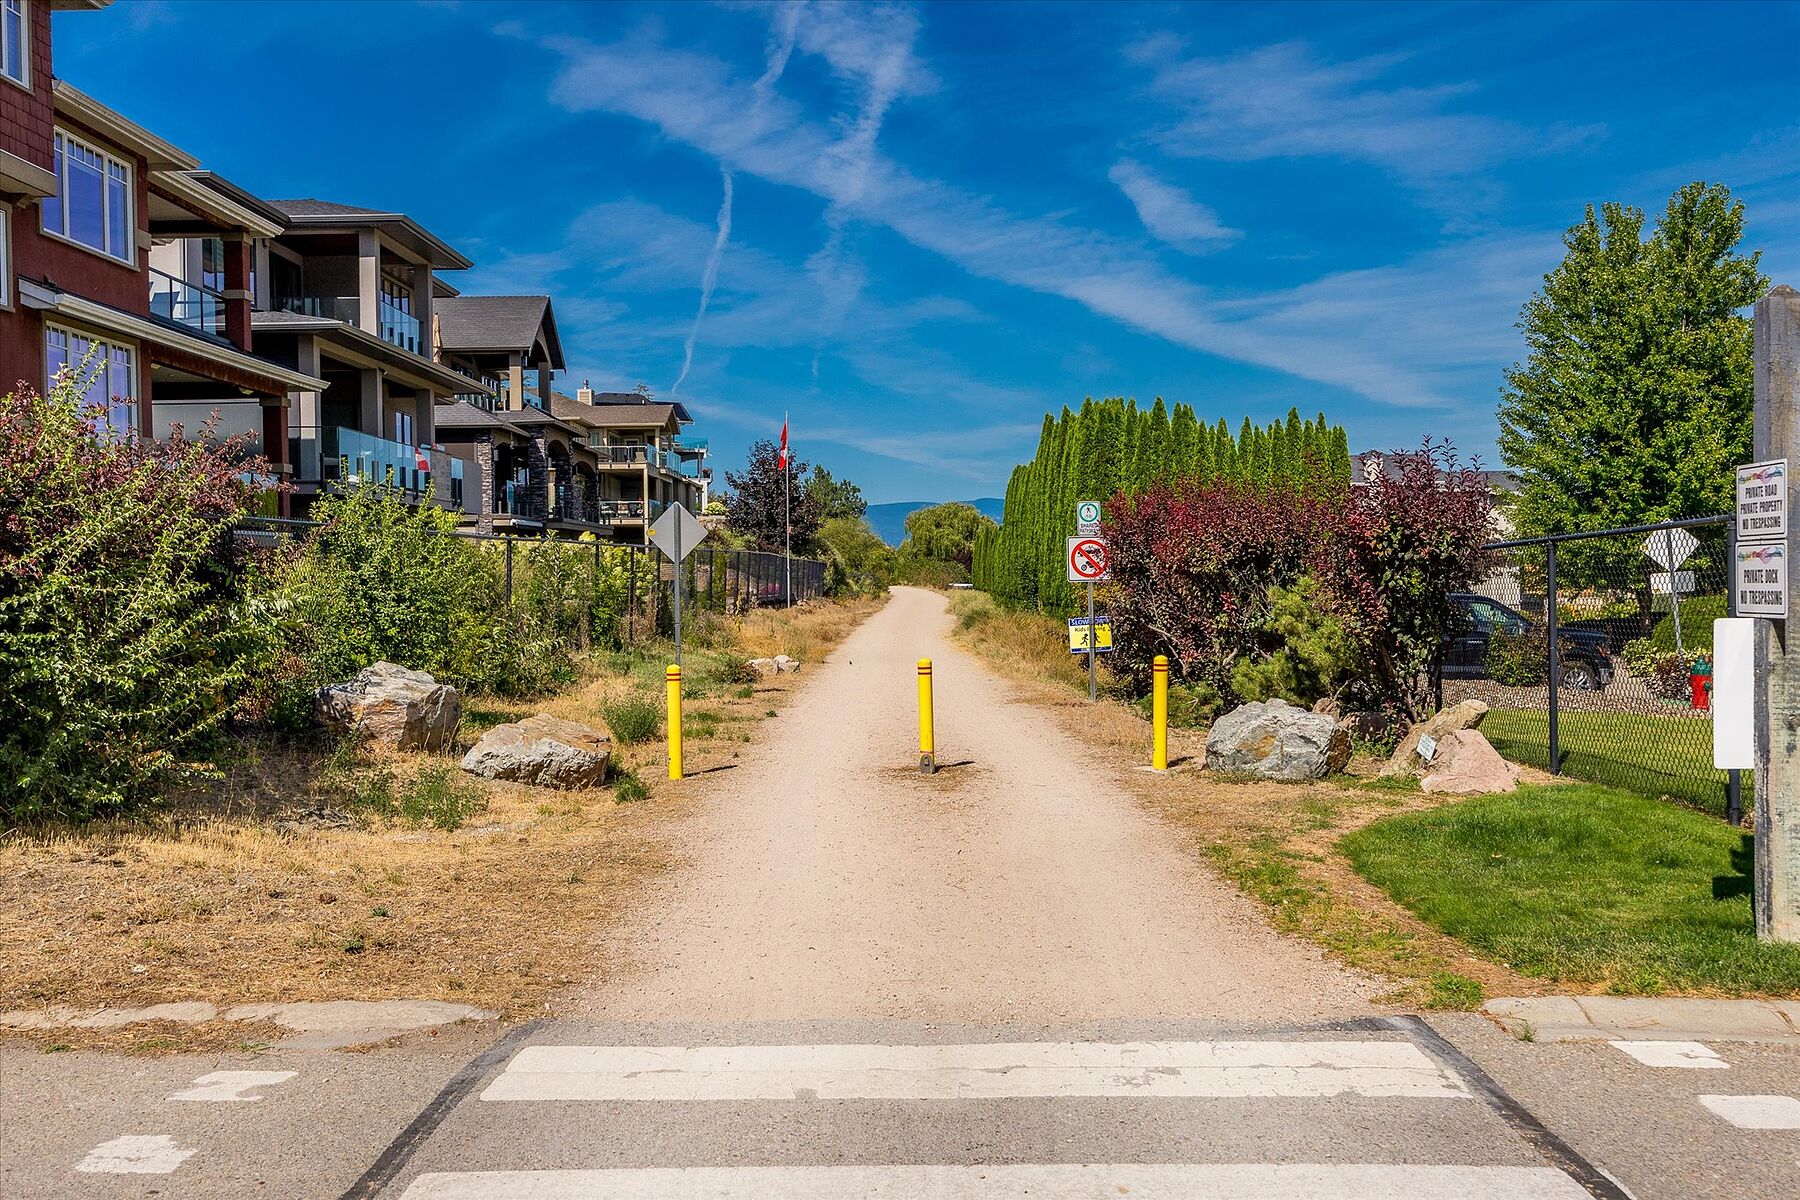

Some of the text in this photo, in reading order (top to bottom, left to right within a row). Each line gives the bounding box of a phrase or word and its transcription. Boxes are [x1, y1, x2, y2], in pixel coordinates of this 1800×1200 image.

[1745, 484, 1777, 499] PRIVATE ROAD
[1740, 499, 1783, 515] PRIVATE PROPERTY
[1742, 515, 1781, 530] NO TRESPASSING
[1743, 569, 1778, 583] PRIVATE DOCK
[1740, 590, 1782, 605] NO TRESPASSING
[1071, 618, 1090, 626] SLOW
